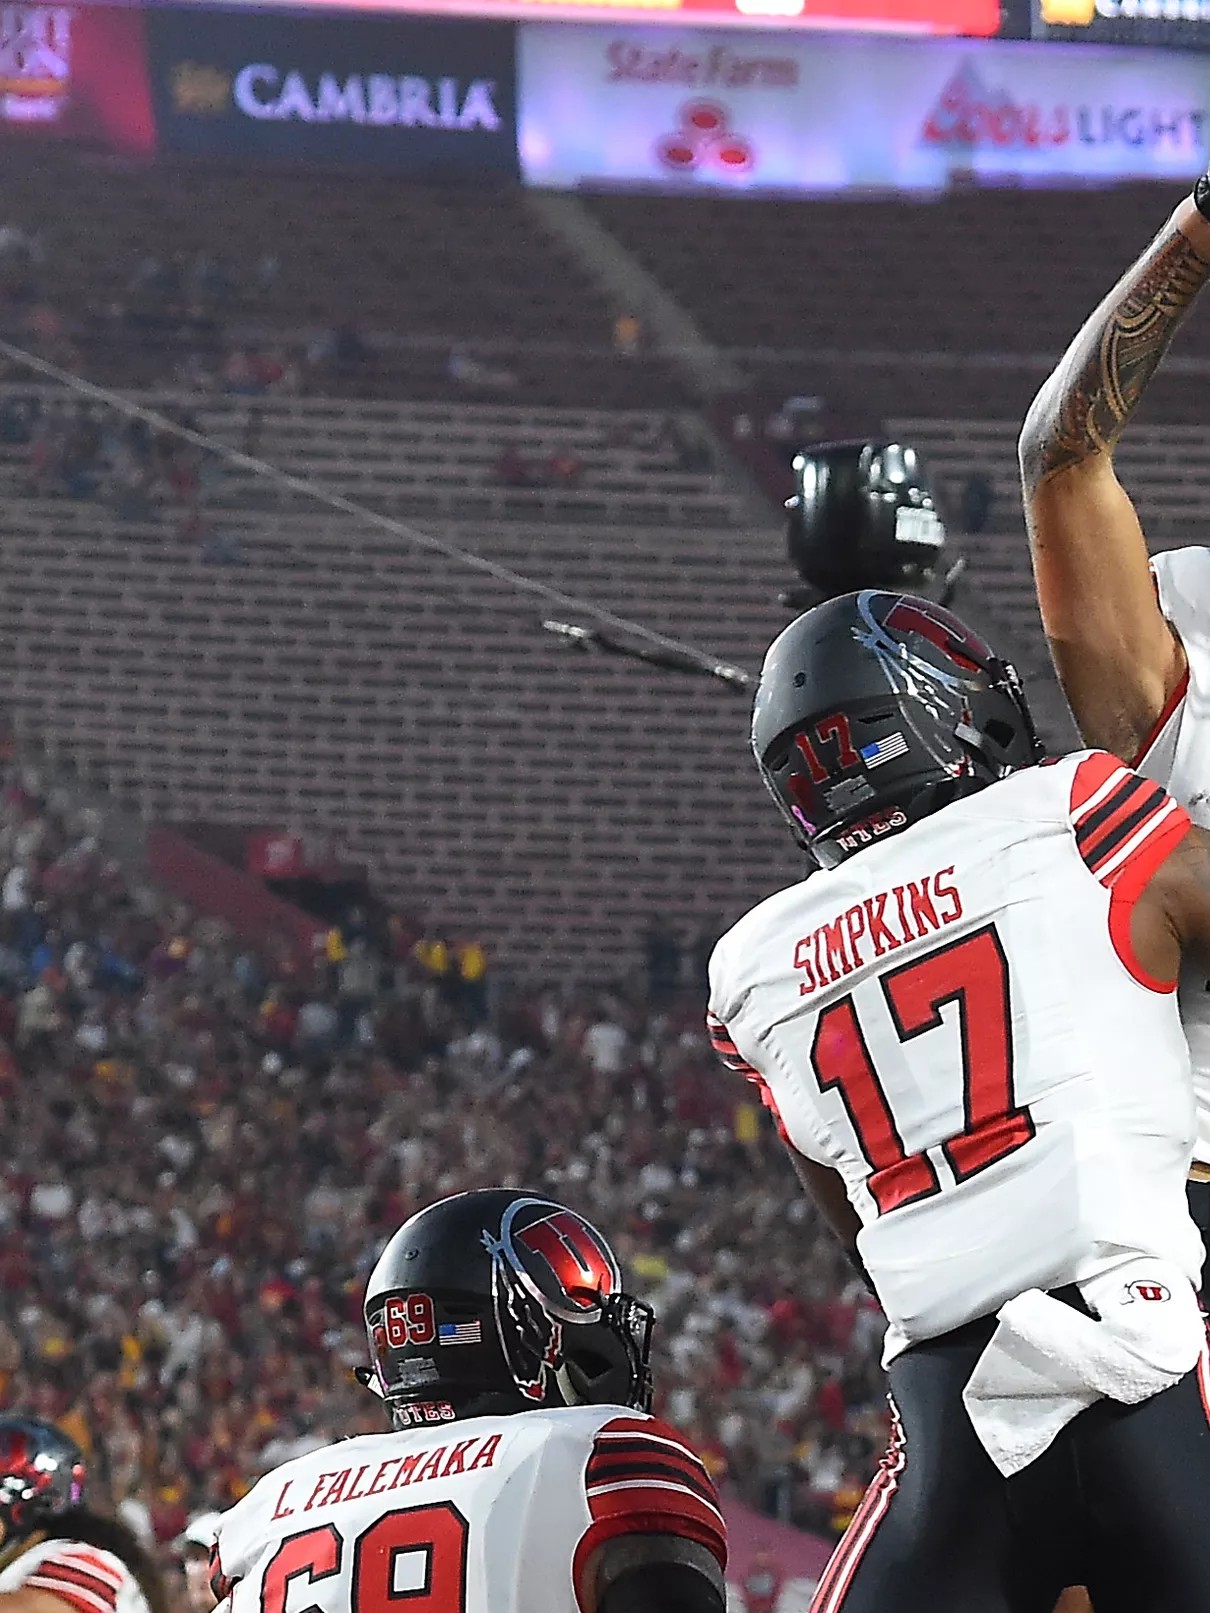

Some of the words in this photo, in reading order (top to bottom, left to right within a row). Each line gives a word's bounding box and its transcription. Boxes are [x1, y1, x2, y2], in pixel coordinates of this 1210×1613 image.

[233, 63, 500, 131] CAMBRIA
[1074, 103, 1207, 146] LIGHT
[795, 711, 861, 785] 17
[793, 864, 963, 996] SIMPKINS
[810, 921, 1037, 1217] 17
[384, 1293, 436, 1349] 69
[303, 1433, 504, 1512] FALEMAKA
